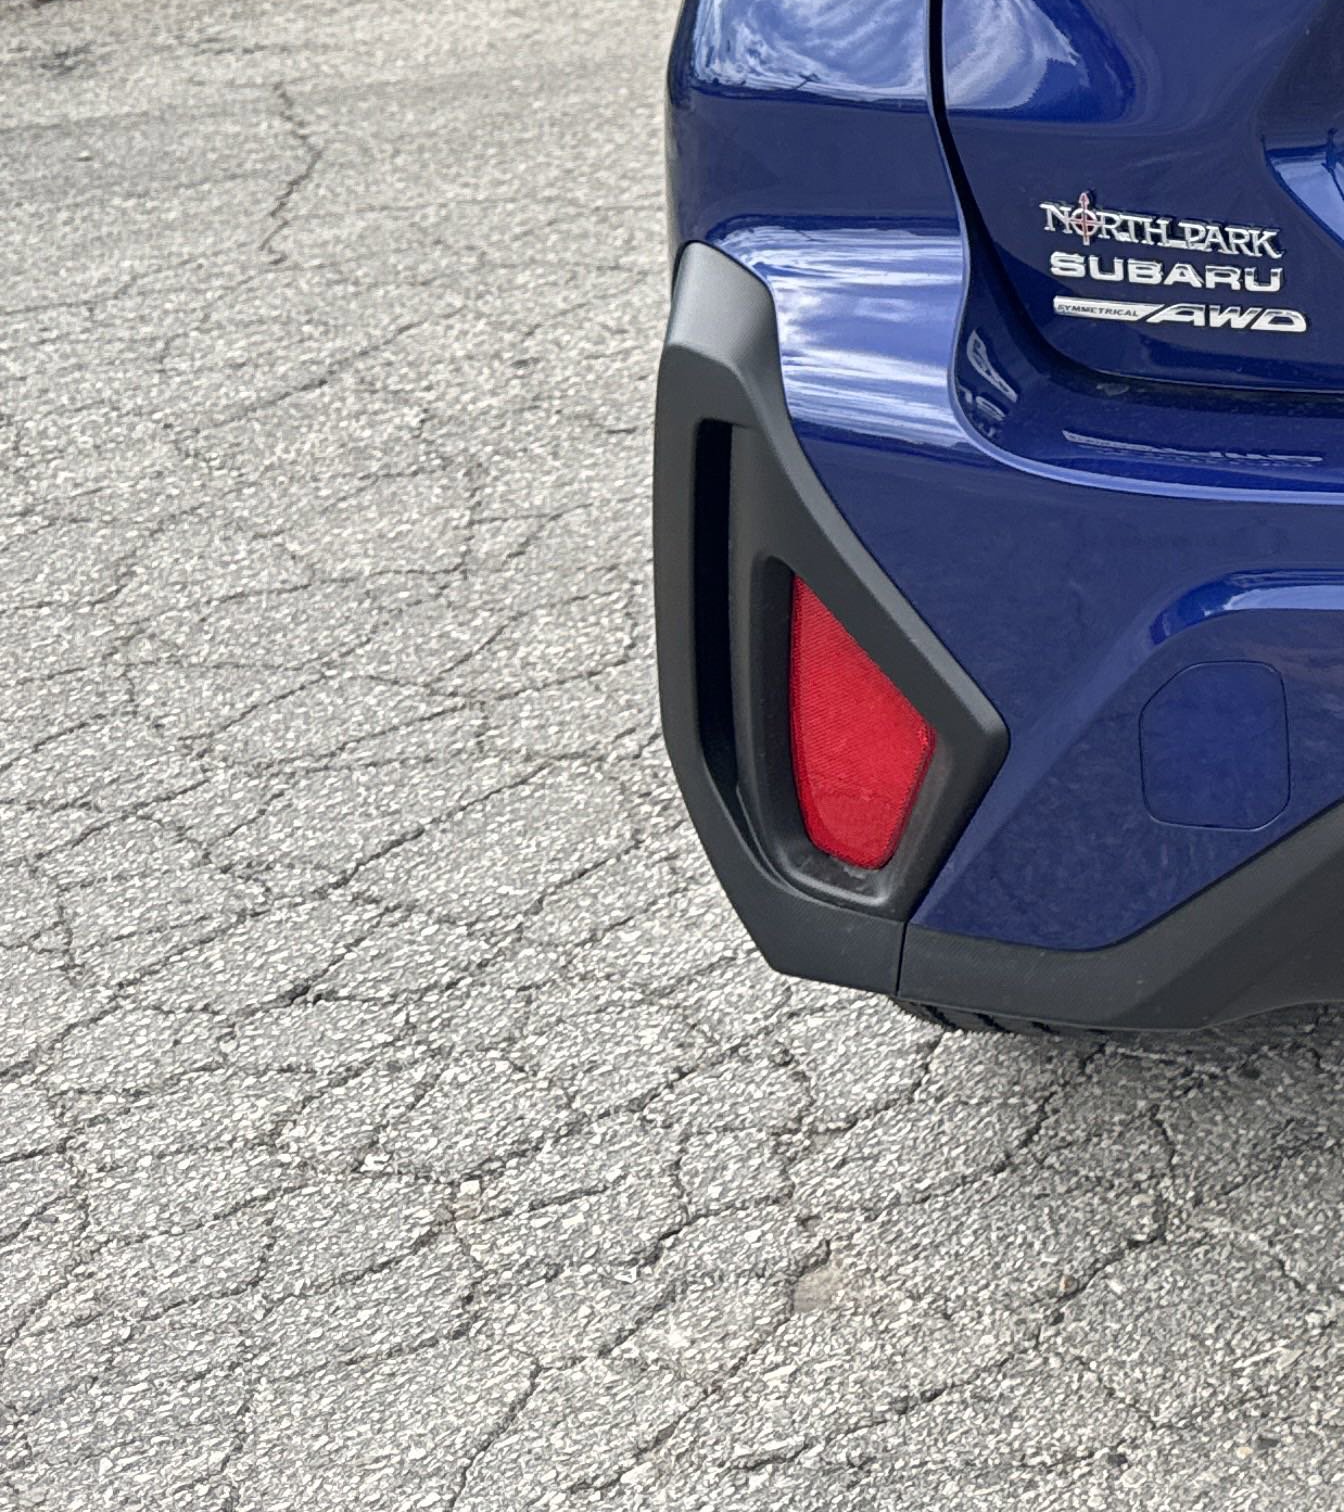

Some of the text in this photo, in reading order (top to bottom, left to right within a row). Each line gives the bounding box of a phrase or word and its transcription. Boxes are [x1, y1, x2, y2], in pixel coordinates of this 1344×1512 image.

[1039, 196, 1284, 259] NORTH PARK
[1050, 251, 1284, 292] SUBARU
[1057, 302, 1307, 333] SYMMETRICAL AWD
